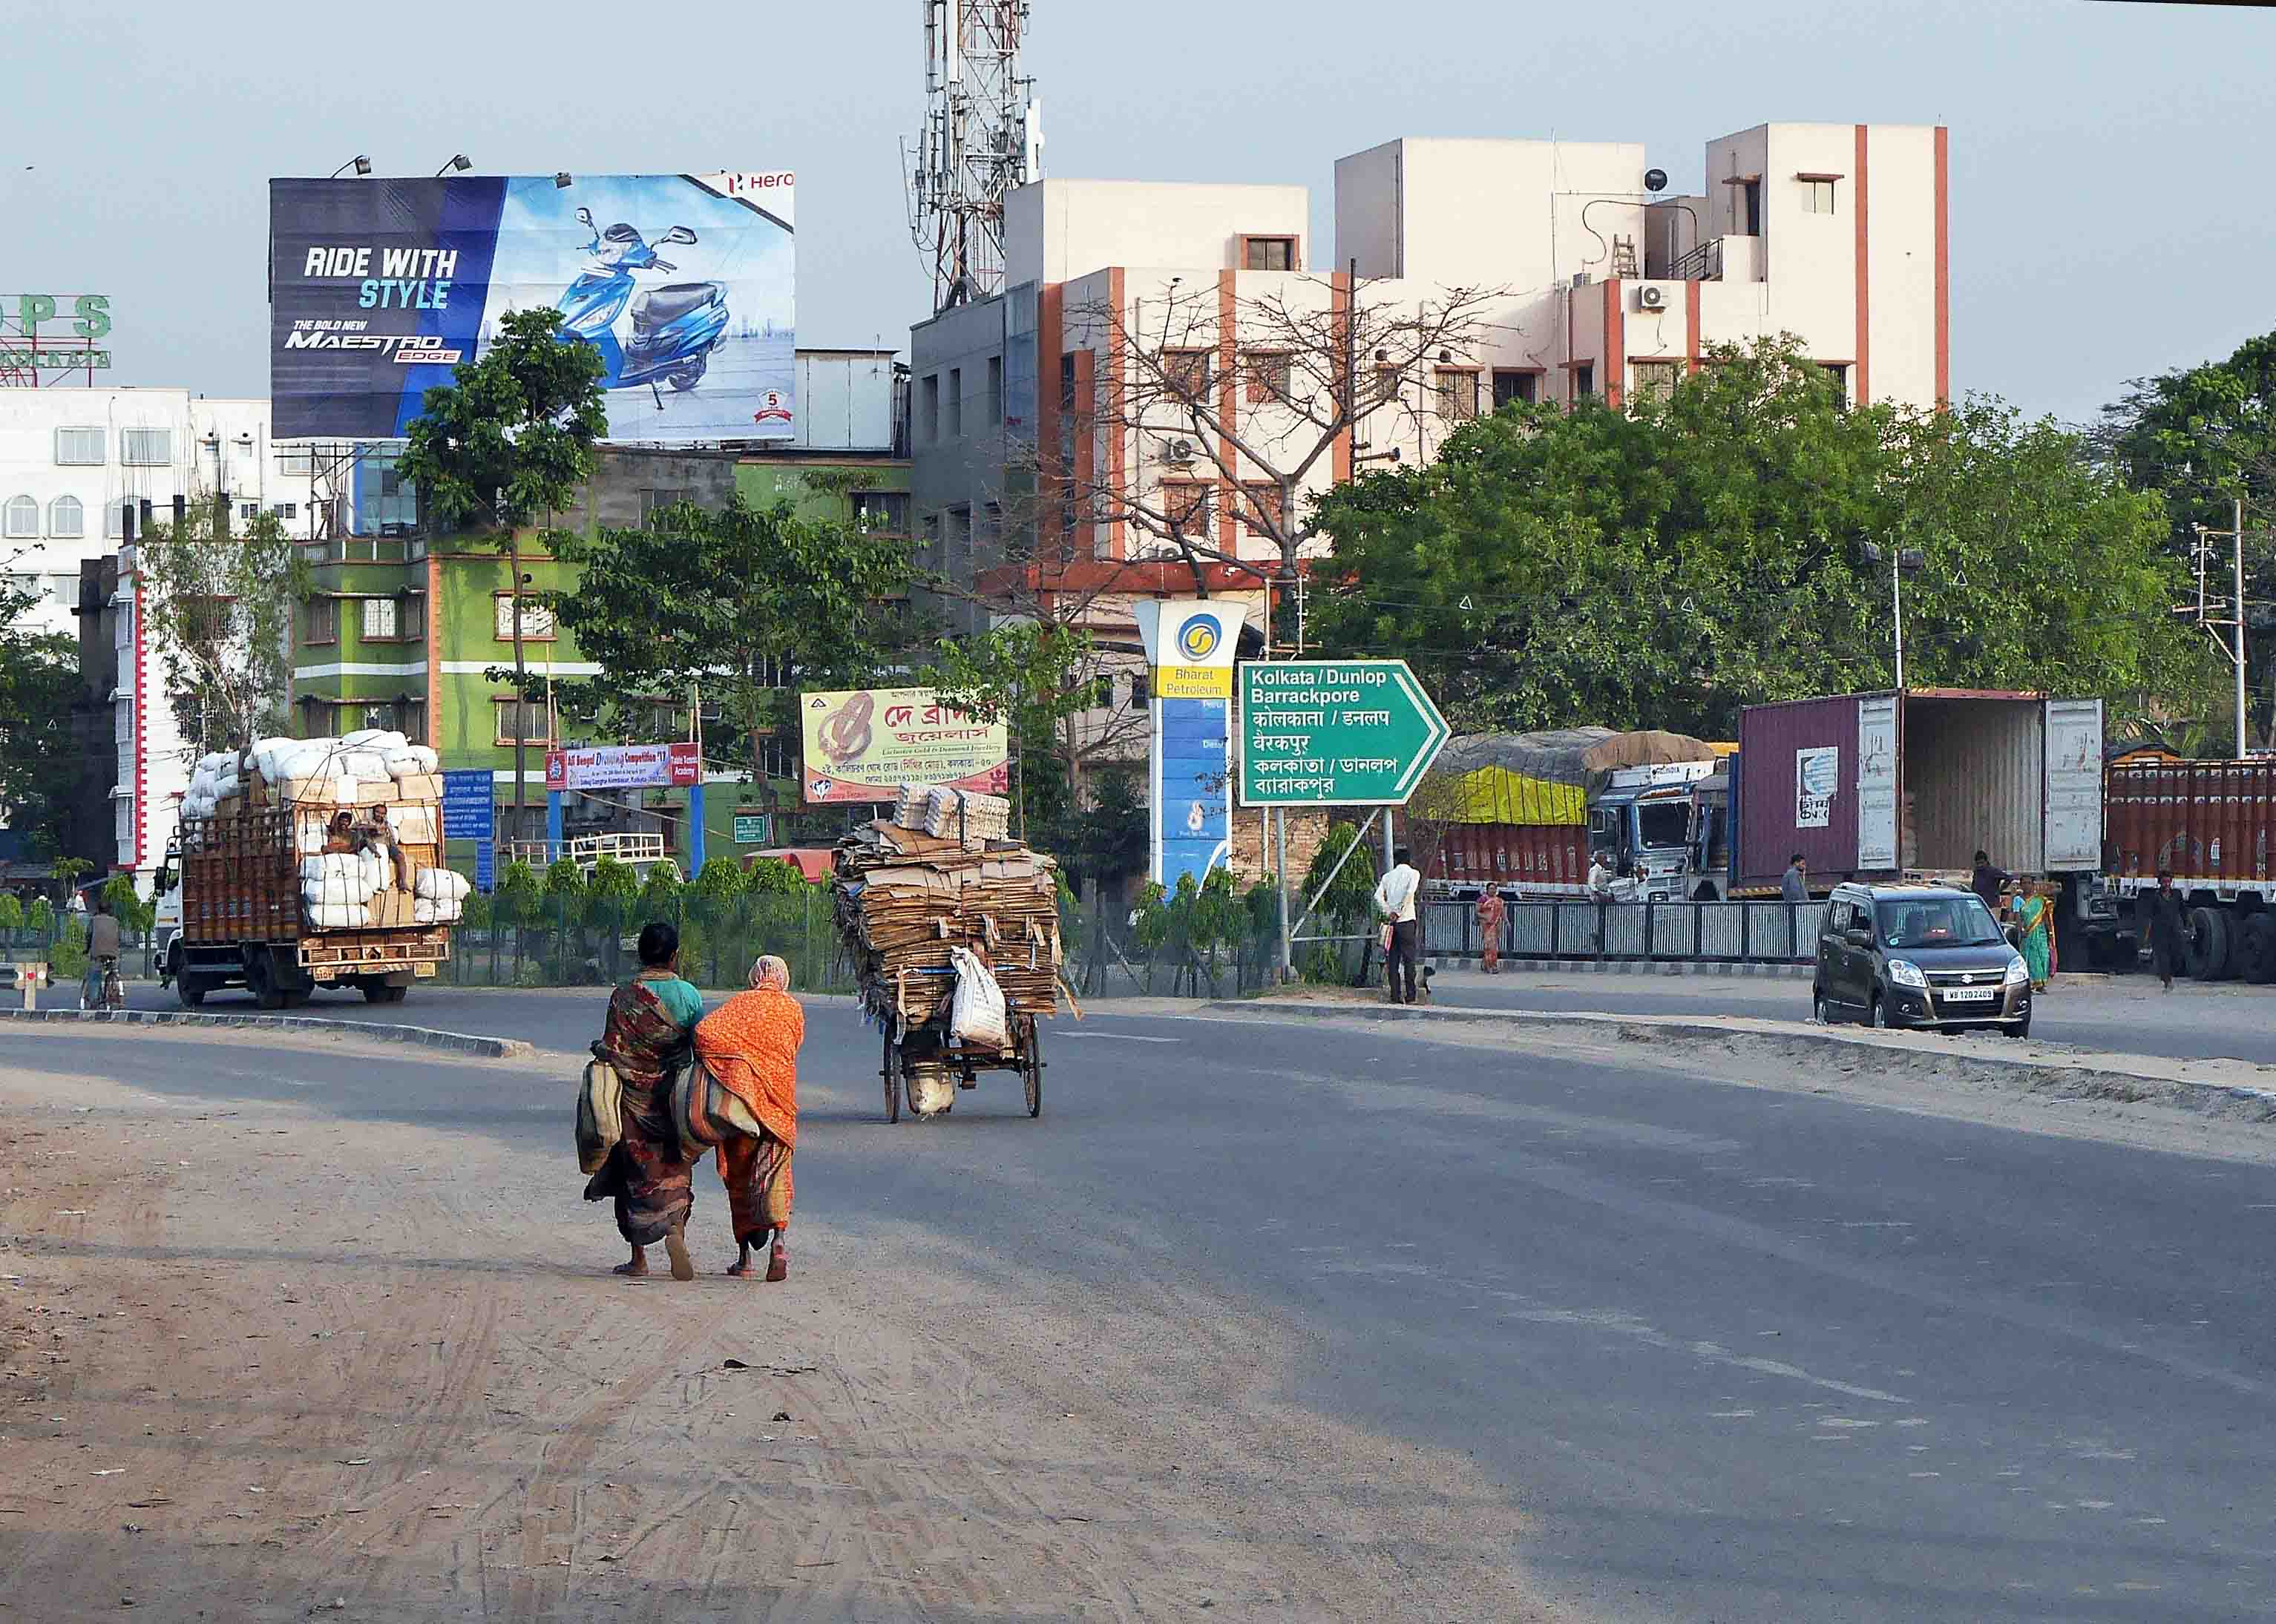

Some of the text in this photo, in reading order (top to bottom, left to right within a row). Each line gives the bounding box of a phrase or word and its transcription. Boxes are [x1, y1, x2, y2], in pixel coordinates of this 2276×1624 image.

[750, 173, 794, 189] Hero
[304, 247, 458, 278] RIDE WITH
[358, 279, 451, 309] STYLE
[0, 295, 111, 338] PS
[293, 320, 368, 331] THE BOLD NEW
[284, 330, 444, 356] MAESTRO
[396, 352, 459, 361] EDGE
[768, 393, 778, 406] 5
[1175, 668, 1214, 680] Bharat
[1251, 669, 1315, 686] Kolkata
[1327, 668, 1386, 688] Dunlop
[1167, 683, 1222, 695] Petroleum
[1251, 688, 1360, 706] Barrackpore
[885, 706, 914, 728] দে
[1252, 706, 1325, 727] कोलकाता
[1342, 710, 1390, 727] डनलप
[892, 725, 992, 745] জুয়েলার্স
[1252, 730, 1311, 756] बैरकपुर
[914, 746, 931, 755] Gold
[939, 745, 969, 754] Diamond
[1253, 757, 1325, 775] কলকাতা
[1339, 757, 1398, 775] ডানলপ
[1253, 776, 1336, 799] ব্যারাকপুর
[1949, 990, 1958, 999] WB
